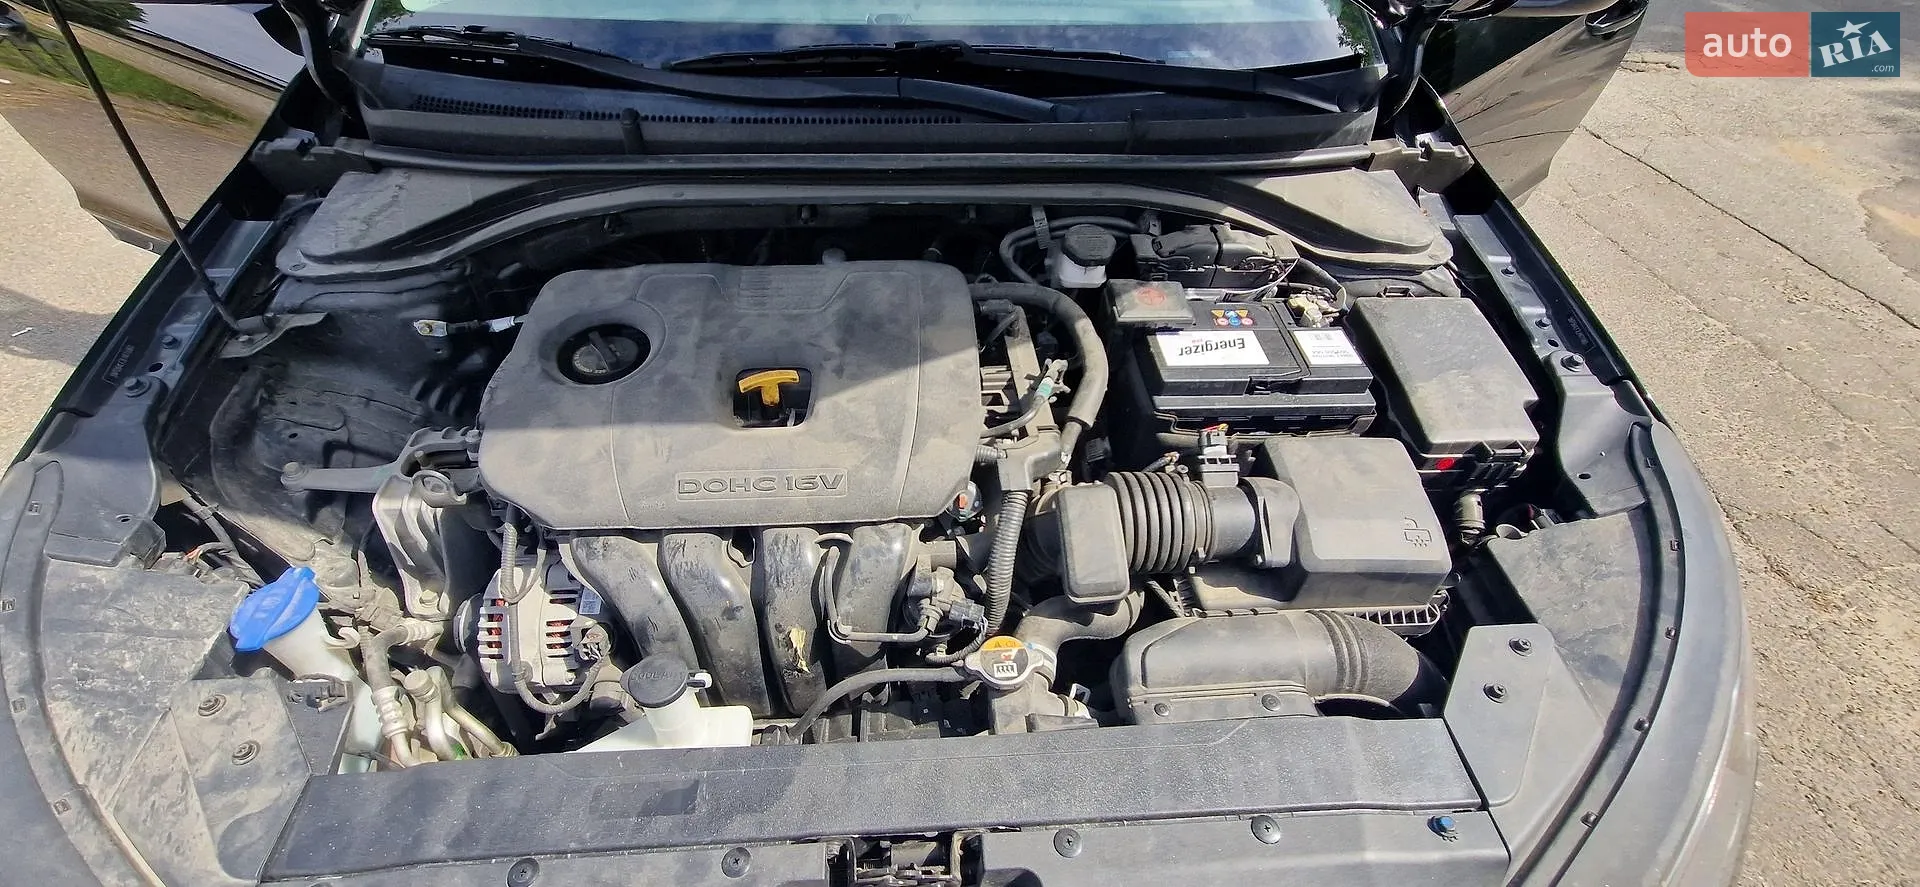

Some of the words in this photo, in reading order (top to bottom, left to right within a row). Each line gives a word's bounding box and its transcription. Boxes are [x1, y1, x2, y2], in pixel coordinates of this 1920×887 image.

[1178, 337, 1245, 356] Energizer
[678, 477, 776, 494] DOHC
[785, 474, 843, 491] 16V
